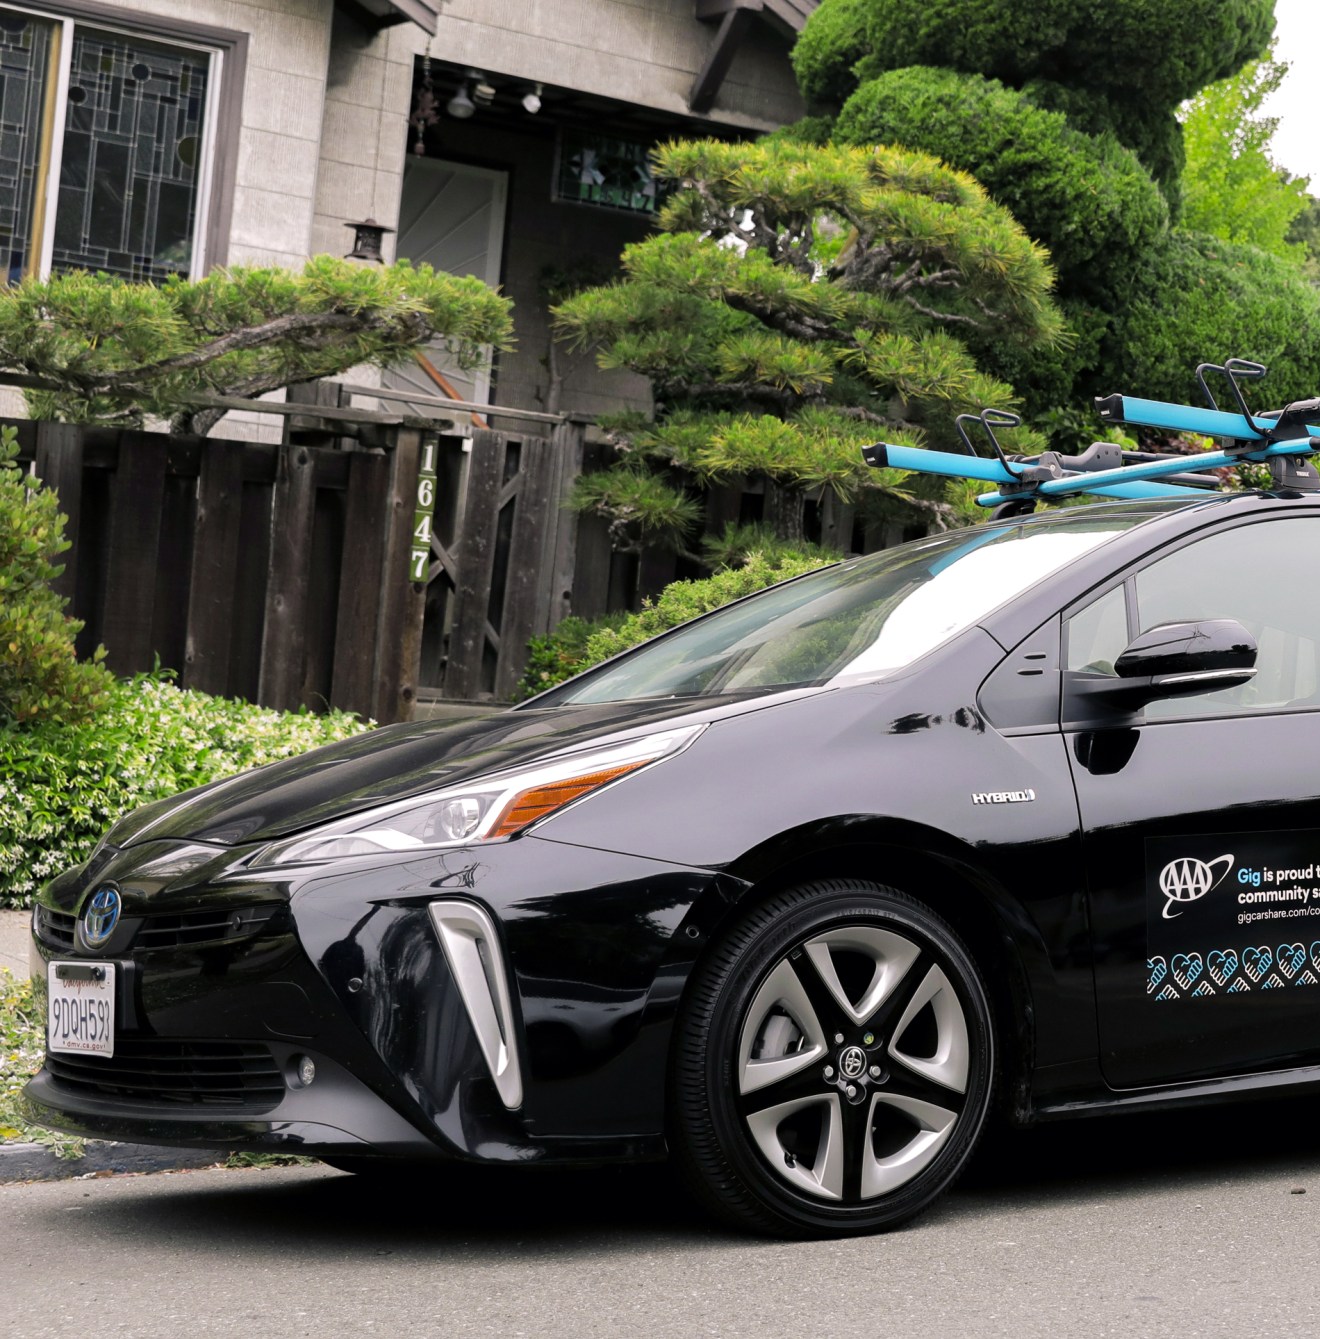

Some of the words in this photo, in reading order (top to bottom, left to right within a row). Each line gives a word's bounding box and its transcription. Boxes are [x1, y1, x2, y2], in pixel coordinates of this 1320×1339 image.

[411, 444, 433, 578] 1647
[972, 790, 1029, 804] HYBRID
[1165, 859, 1210, 899] AAA
[1237, 868, 1261, 886] Gig
[1263, 866, 1274, 882] is
[1276, 863, 1314, 885] proud
[1237, 886, 1309, 904] community
[53, 998, 110, 1042] 9DQH593
[66, 1041, 104, 1050] dmv.ca.gov
